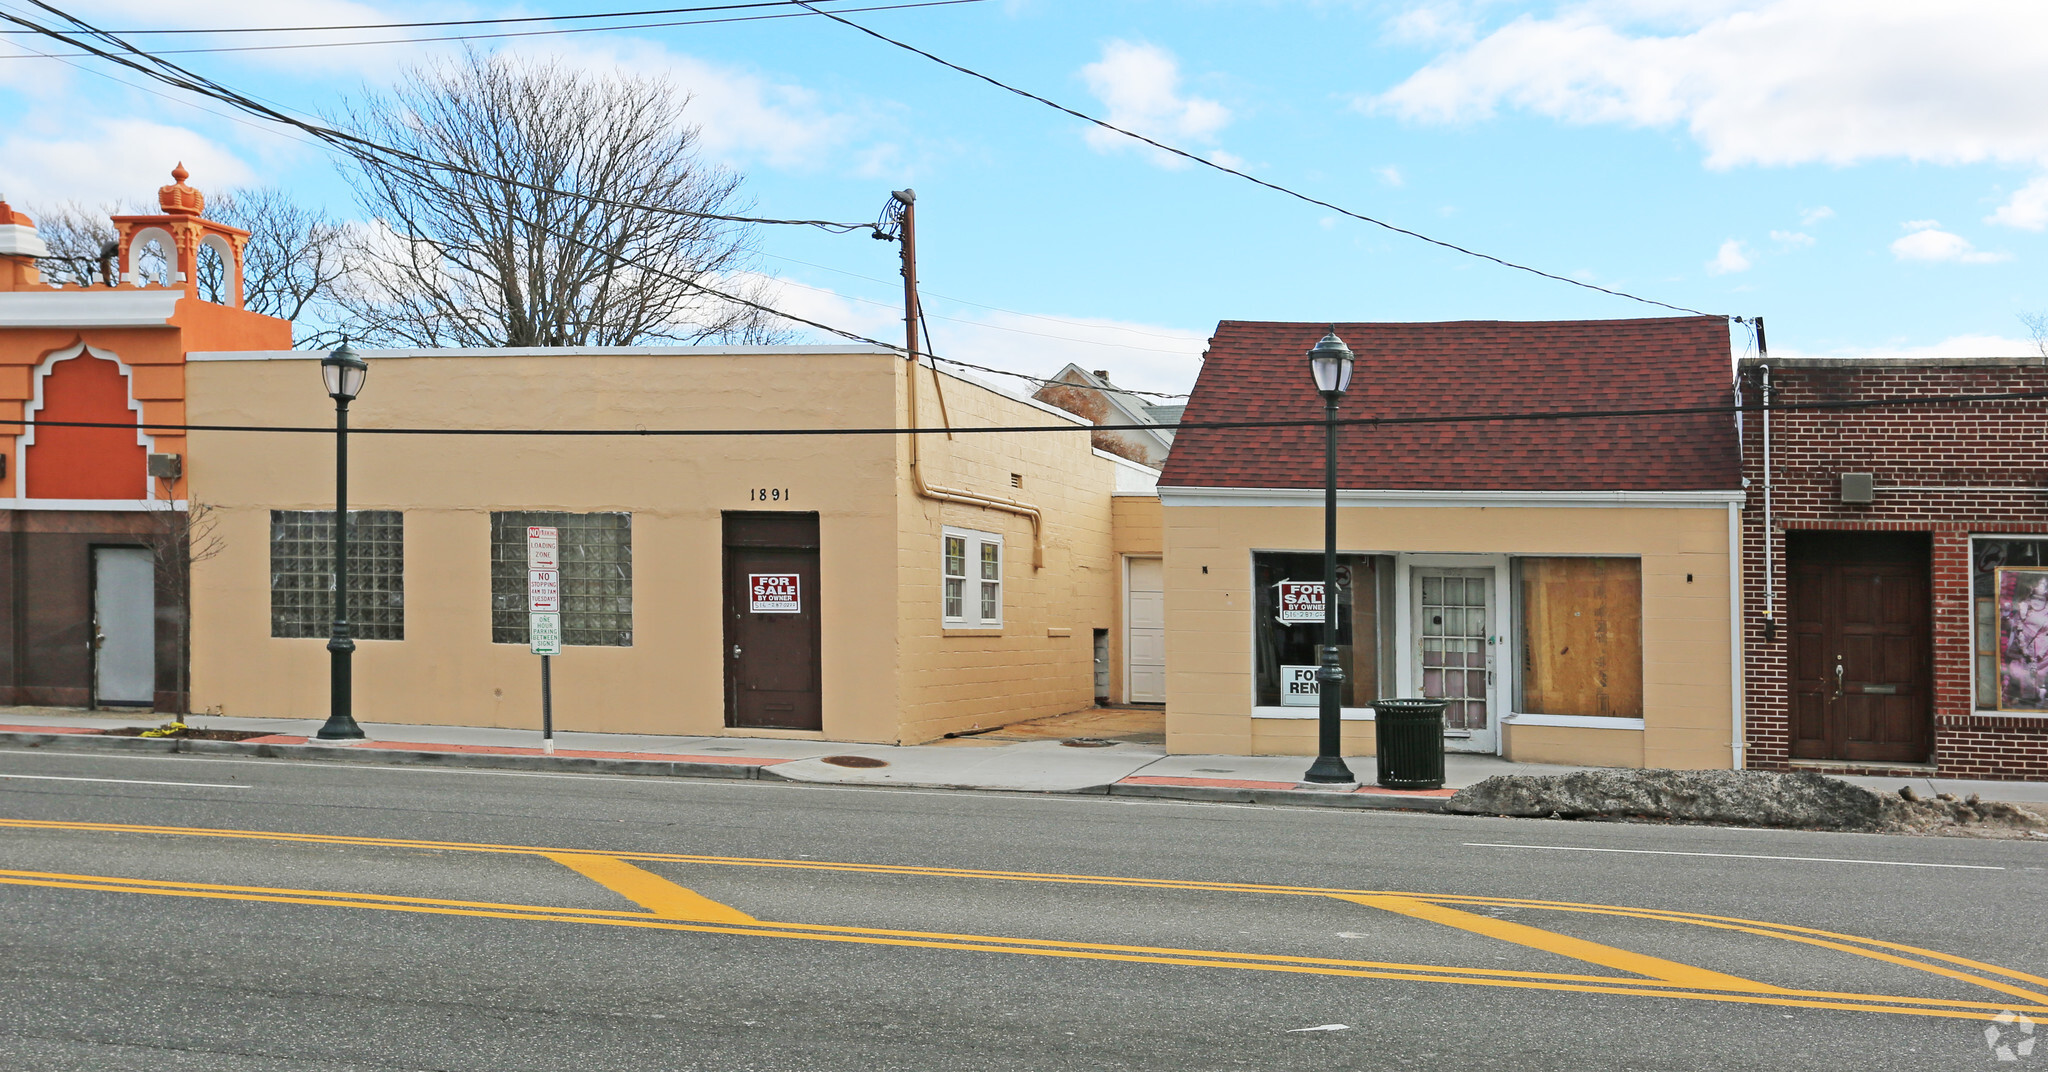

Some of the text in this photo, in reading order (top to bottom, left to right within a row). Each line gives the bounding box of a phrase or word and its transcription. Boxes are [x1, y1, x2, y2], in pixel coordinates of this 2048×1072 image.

[751, 488, 789, 501] 1891
[529, 528, 539, 537] NO
[538, 572, 550, 581] NO
[760, 577, 790, 586] FOR
[753, 585, 796, 595] SALE
[1290, 585, 1325, 594] FOR
[1294, 669, 1317, 681] FO
[1289, 682, 1319, 694] REN
